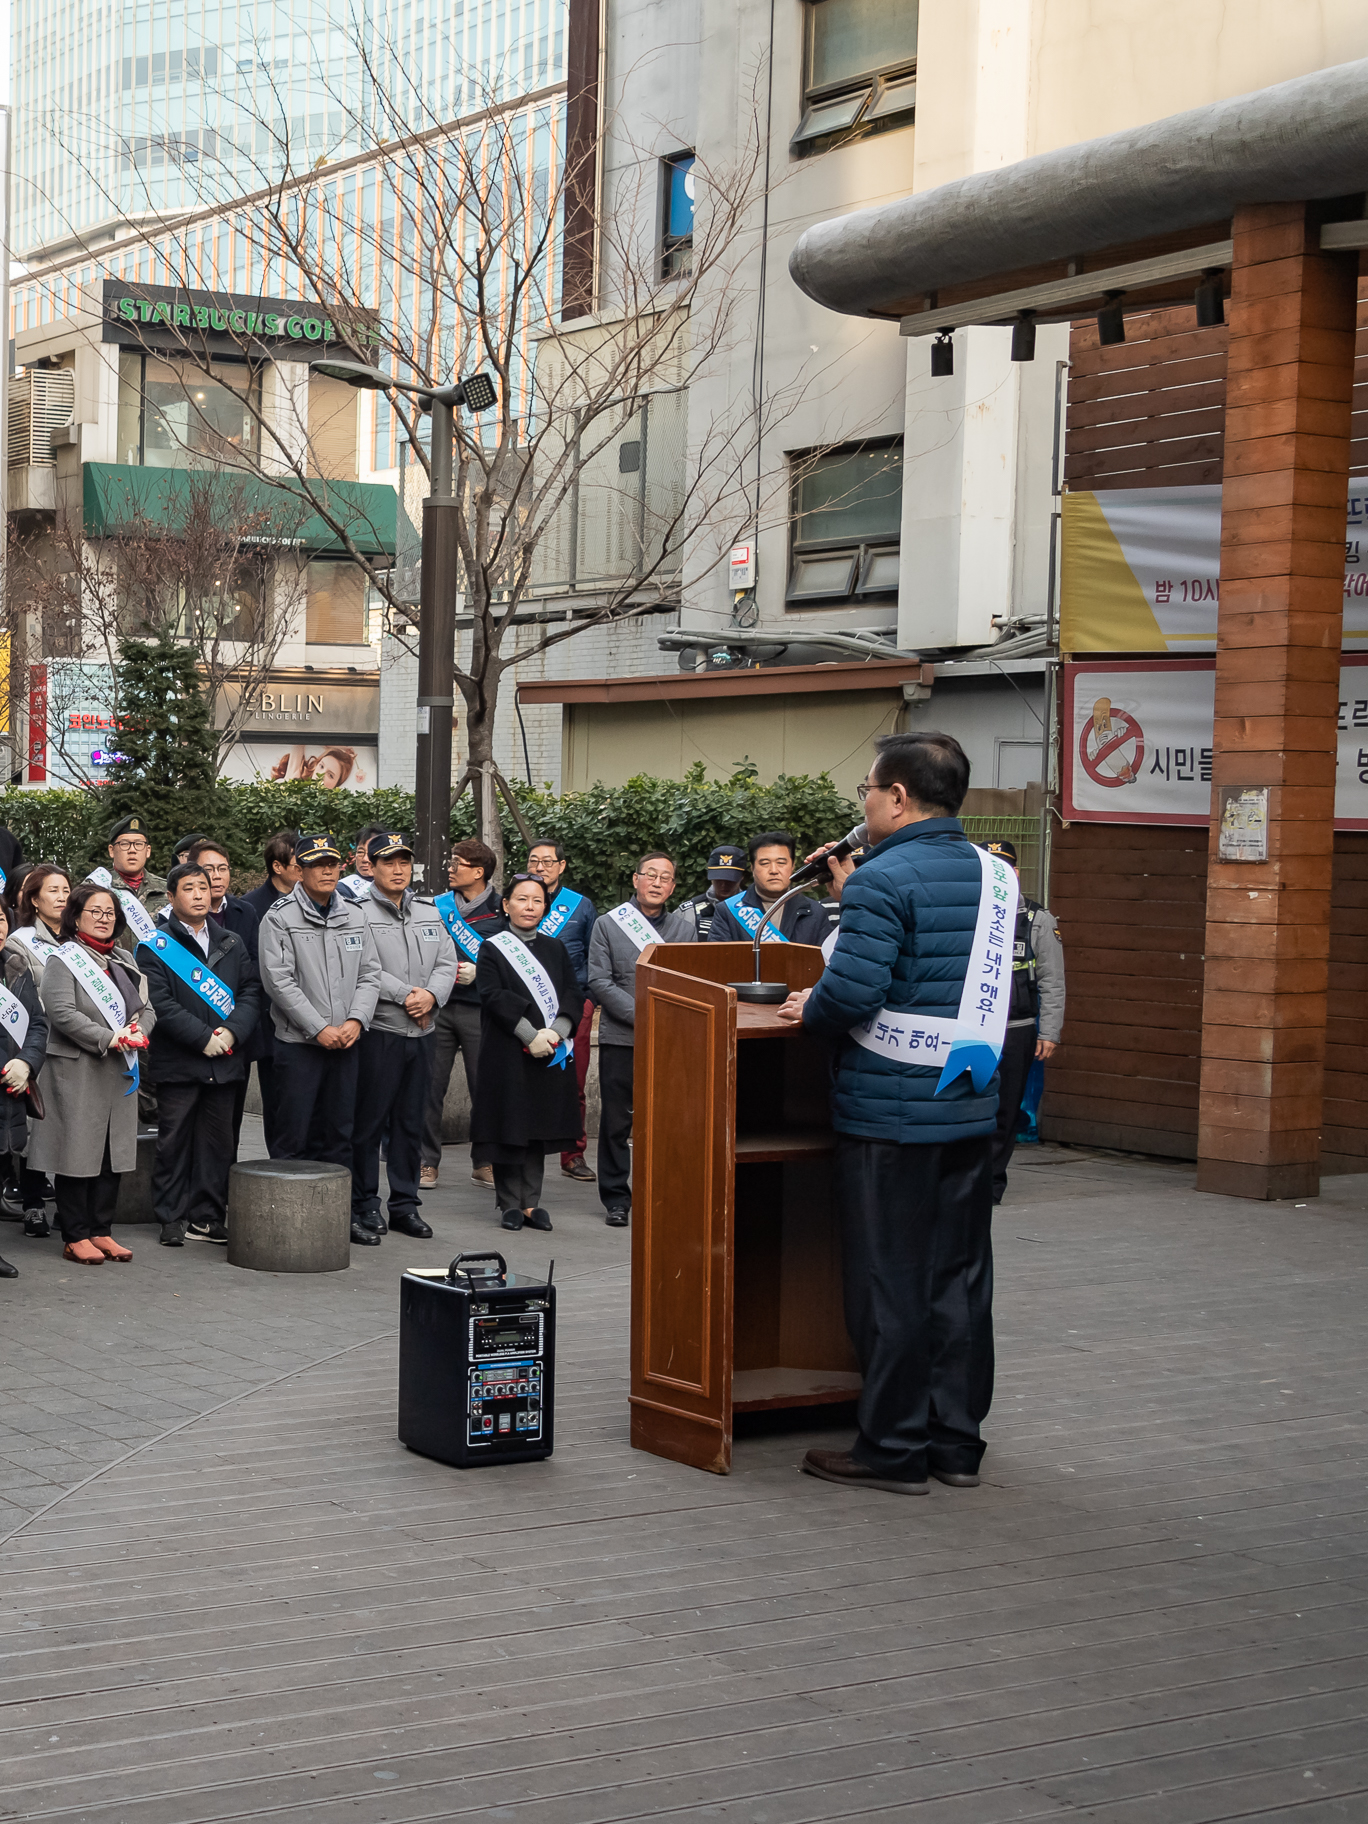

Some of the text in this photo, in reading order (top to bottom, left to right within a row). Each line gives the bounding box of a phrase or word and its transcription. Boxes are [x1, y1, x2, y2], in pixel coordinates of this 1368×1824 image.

[118, 297, 280, 336] STARBUCKS
[1154, 580, 1173, 604] 밤
[256, 712, 311, 721] LINGERIE
[992, 885, 1009, 902] 앞
[988, 903, 1007, 948] 청소는
[982, 949, 1002, 980] 내가
[532, 974, 549, 997] 청소는
[0, 1002, 20, 1021] 광진구
[89, 977, 106, 996] 점포
[101, 992, 114, 1006] 앞
[109, 1003, 126, 1027] 청소는
[976, 982, 999, 1027] 해요!
[875, 1021, 952, 1052] 내가 해요!
